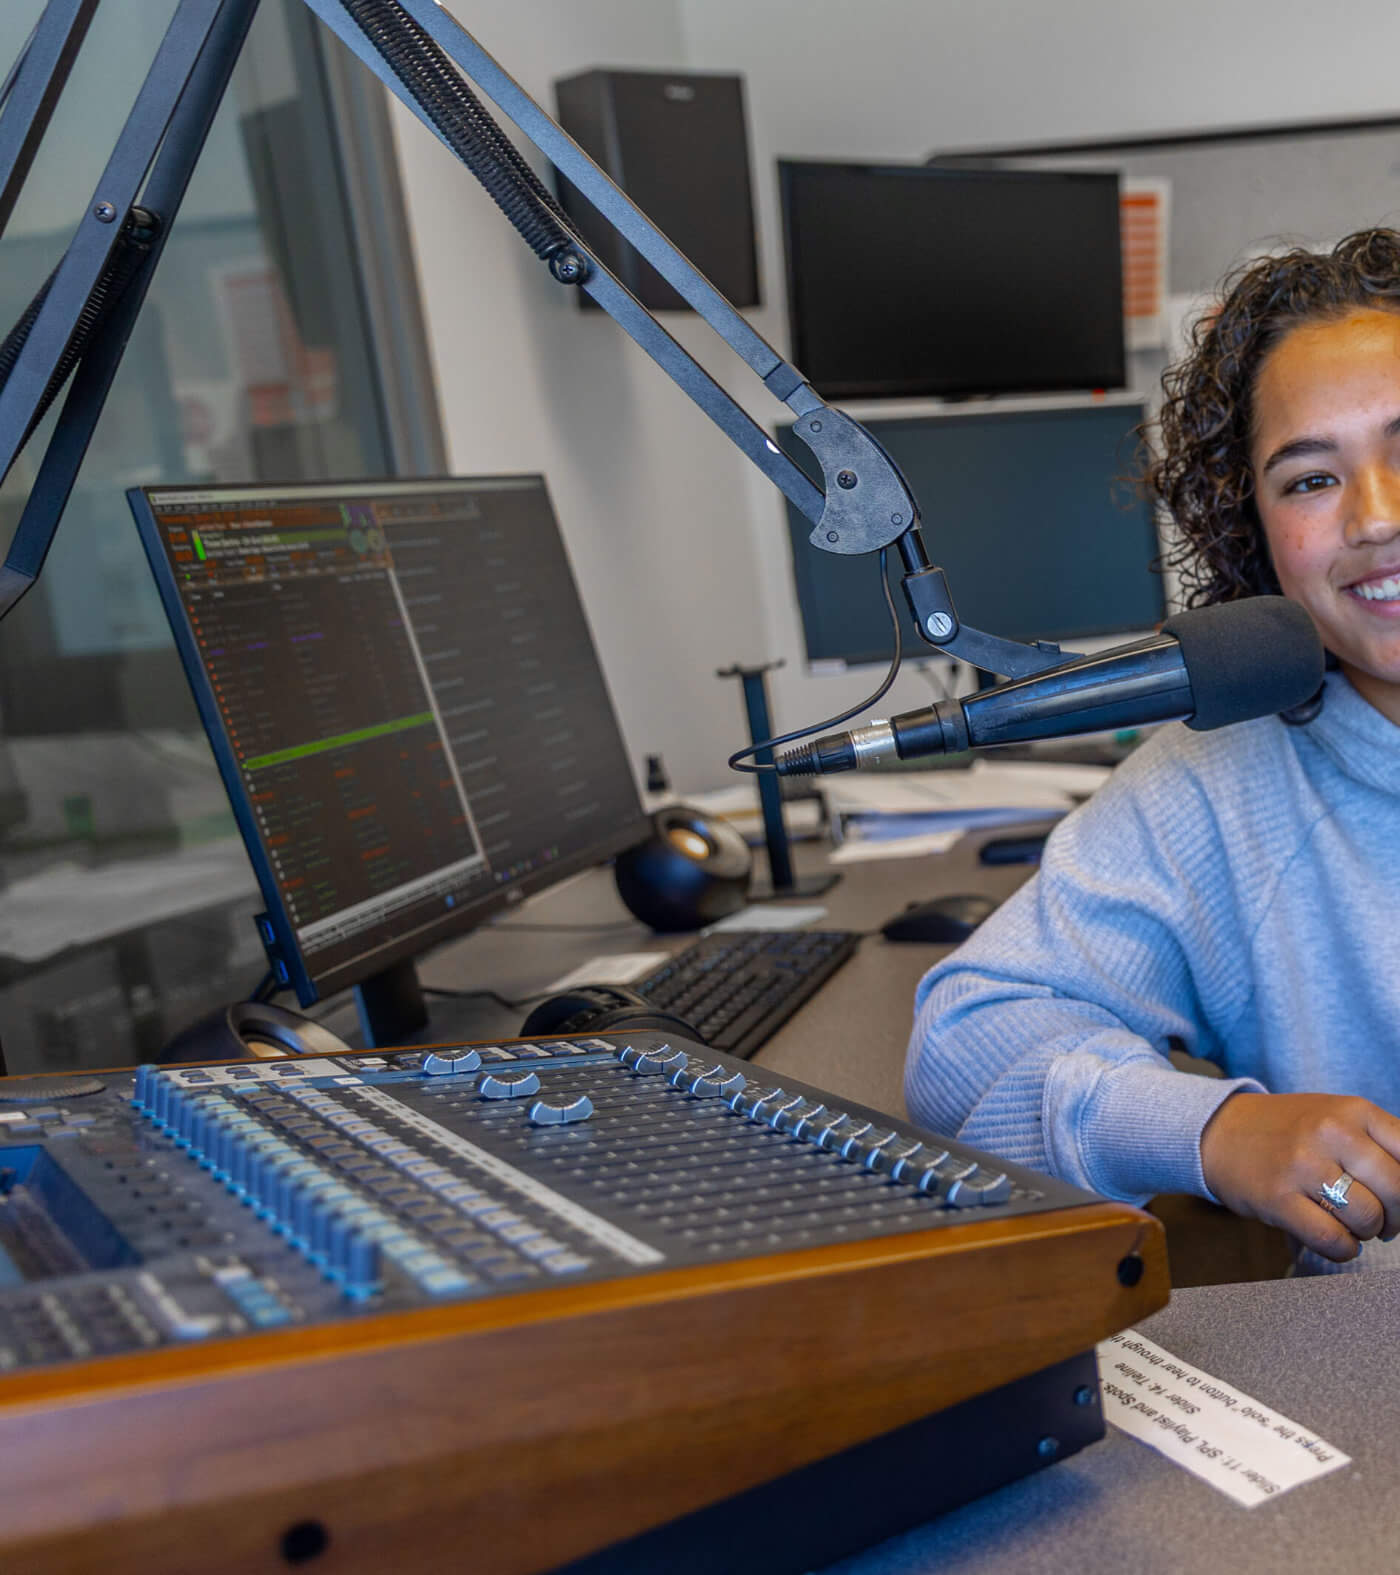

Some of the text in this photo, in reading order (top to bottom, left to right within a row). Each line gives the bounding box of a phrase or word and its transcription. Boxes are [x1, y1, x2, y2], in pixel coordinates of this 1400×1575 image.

[1121, 1340, 1165, 1366] through
[1114, 1362, 1150, 1386] Tieline
[1161, 1362, 1189, 1380] hear
[1185, 1376, 1202, 1387] to
[1165, 1393, 1201, 1415] Slider
[1199, 1383, 1238, 1408] button
[1130, 1402, 1158, 1418] and
[1153, 1414, 1199, 1443] Playlist
[1273, 1426, 1297, 1440] the
[1197, 1439, 1223, 1459] SPL
[1294, 1436, 1335, 1463] Press
